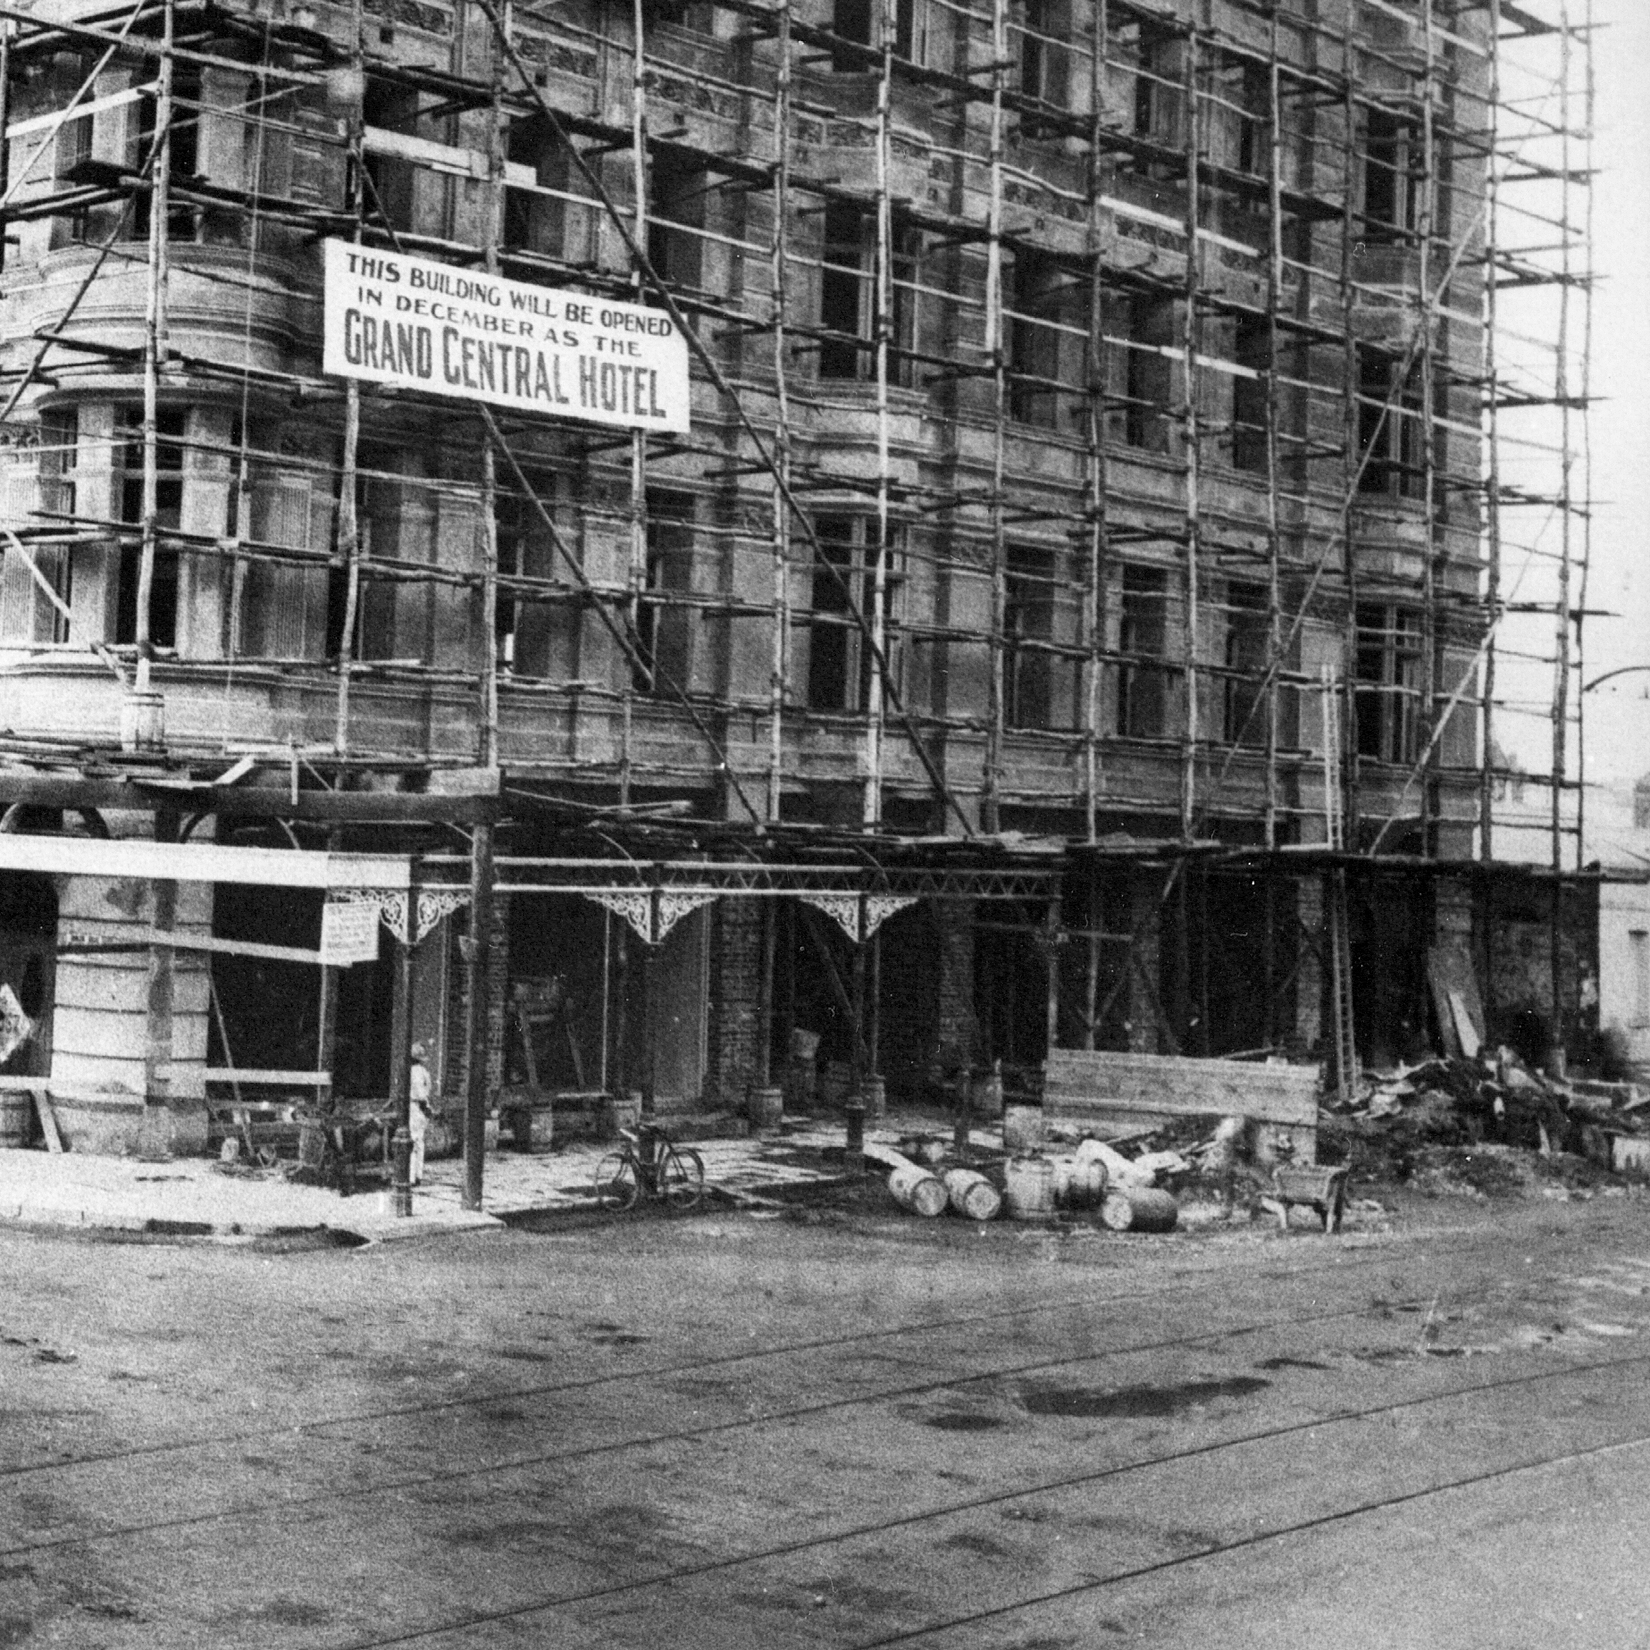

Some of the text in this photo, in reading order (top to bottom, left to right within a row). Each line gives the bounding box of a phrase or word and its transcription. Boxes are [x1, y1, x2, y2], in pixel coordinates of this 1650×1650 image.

[347, 253, 672, 337] THIS BUILDING WILL BE OPENED
[358, 286, 642, 358] IN DECEMBER AS THE
[344, 308, 667, 419] GRAND CENTRAL HOTEL
